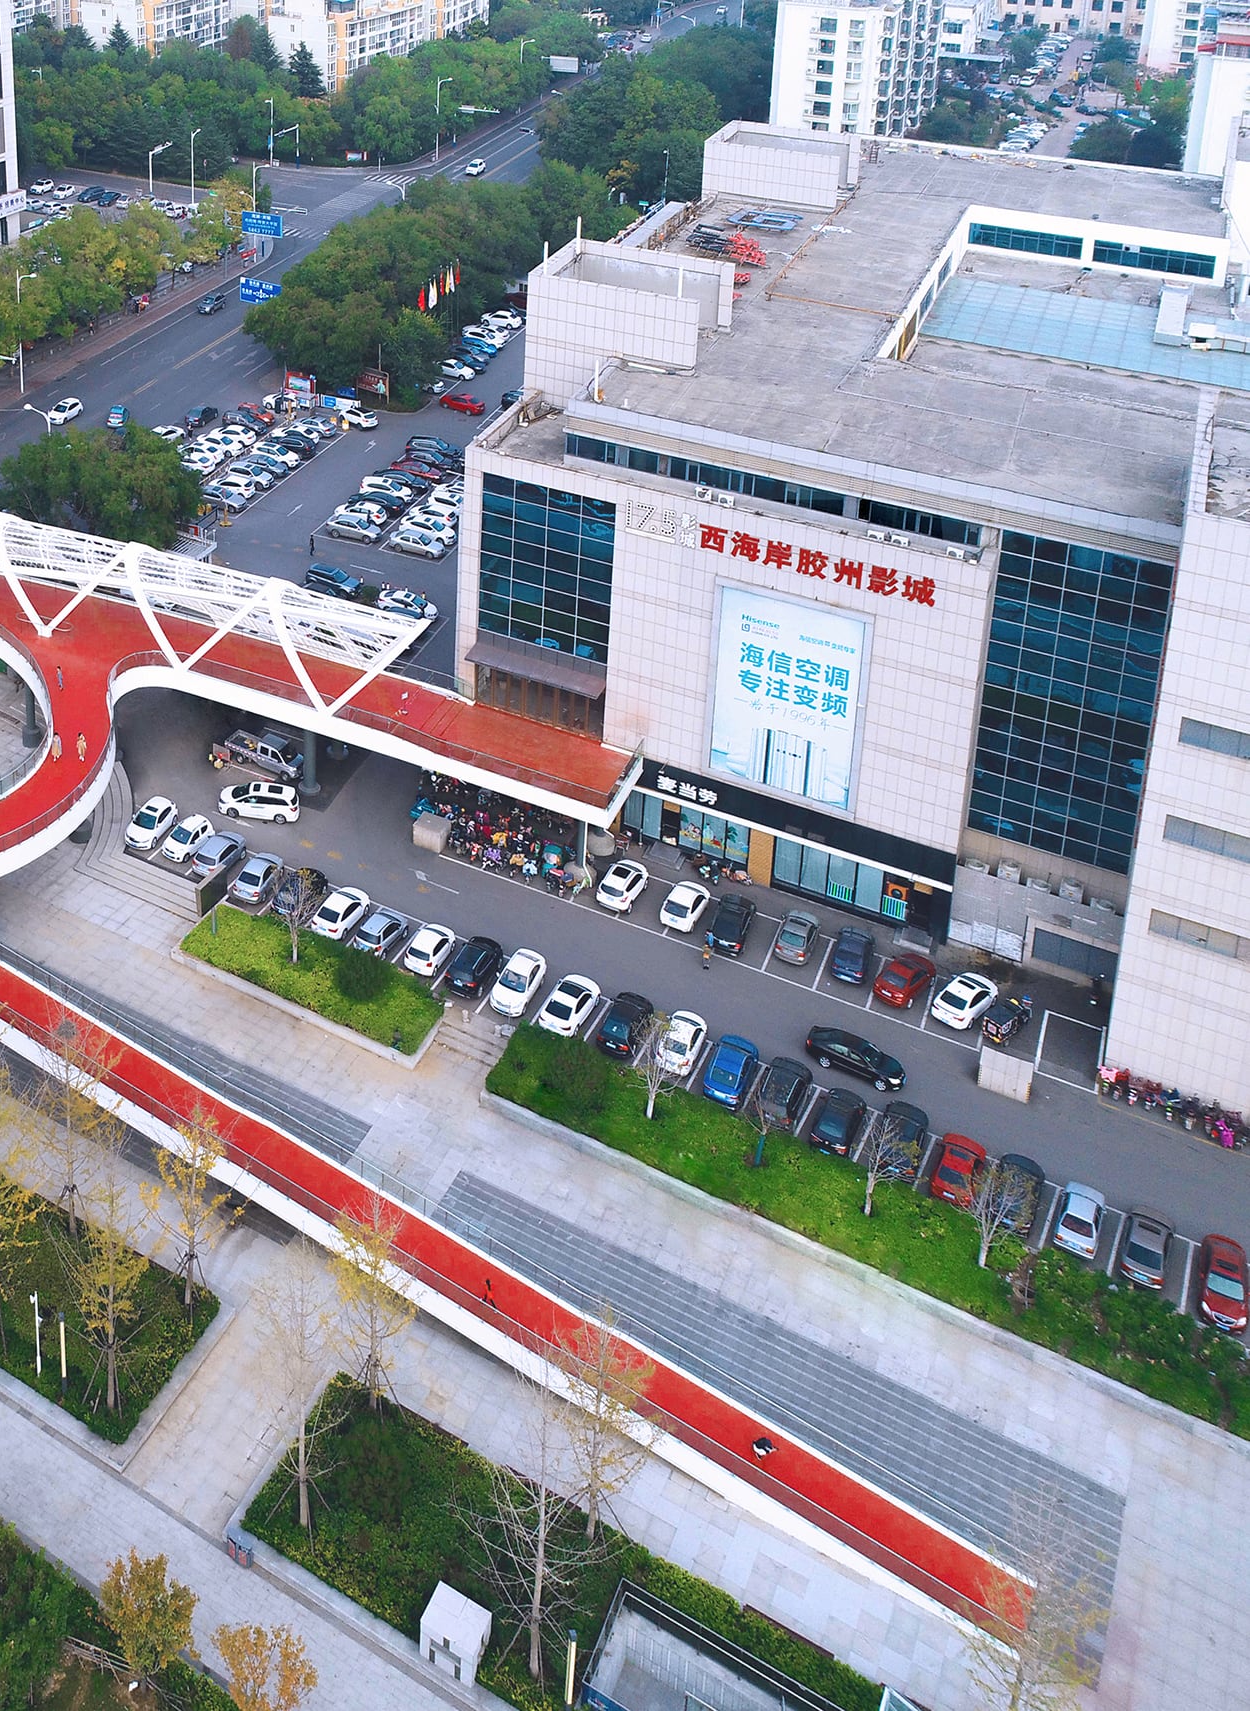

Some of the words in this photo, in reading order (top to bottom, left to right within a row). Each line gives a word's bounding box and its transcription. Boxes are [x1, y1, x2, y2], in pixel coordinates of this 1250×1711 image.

[626, 500, 678, 537] 17.5
[679, 513, 697, 550] 影城
[699, 522, 936, 608] 西海岸胶州影城
[741, 613, 780, 630] Hisense
[739, 641, 850, 692] 海信空调
[738, 669, 849, 719] 专注变频
[656, 773, 718, 806] 麦当劳
